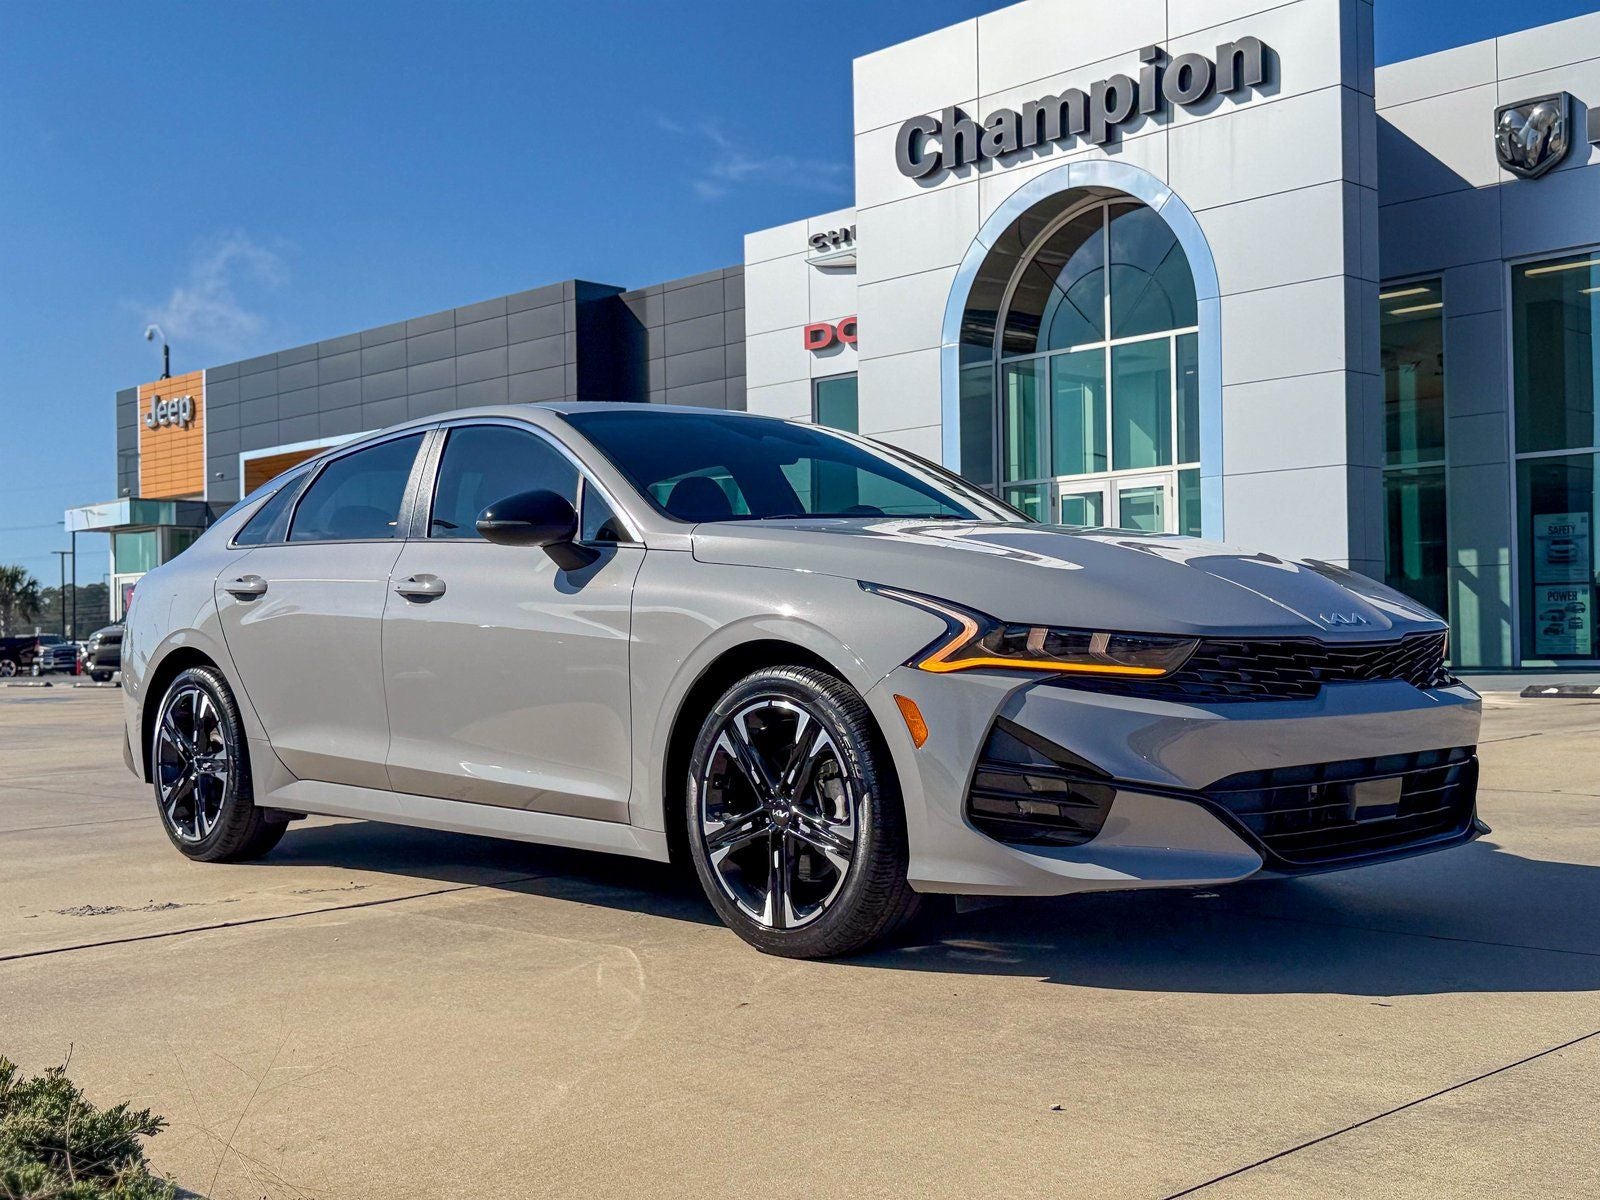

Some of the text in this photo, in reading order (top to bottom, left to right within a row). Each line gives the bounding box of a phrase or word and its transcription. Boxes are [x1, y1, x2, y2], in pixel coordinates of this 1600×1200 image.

[895, 35, 1264, 179] Champion
[144, 394, 192, 428] Jeep
[1547, 591, 1577, 601] POWER
